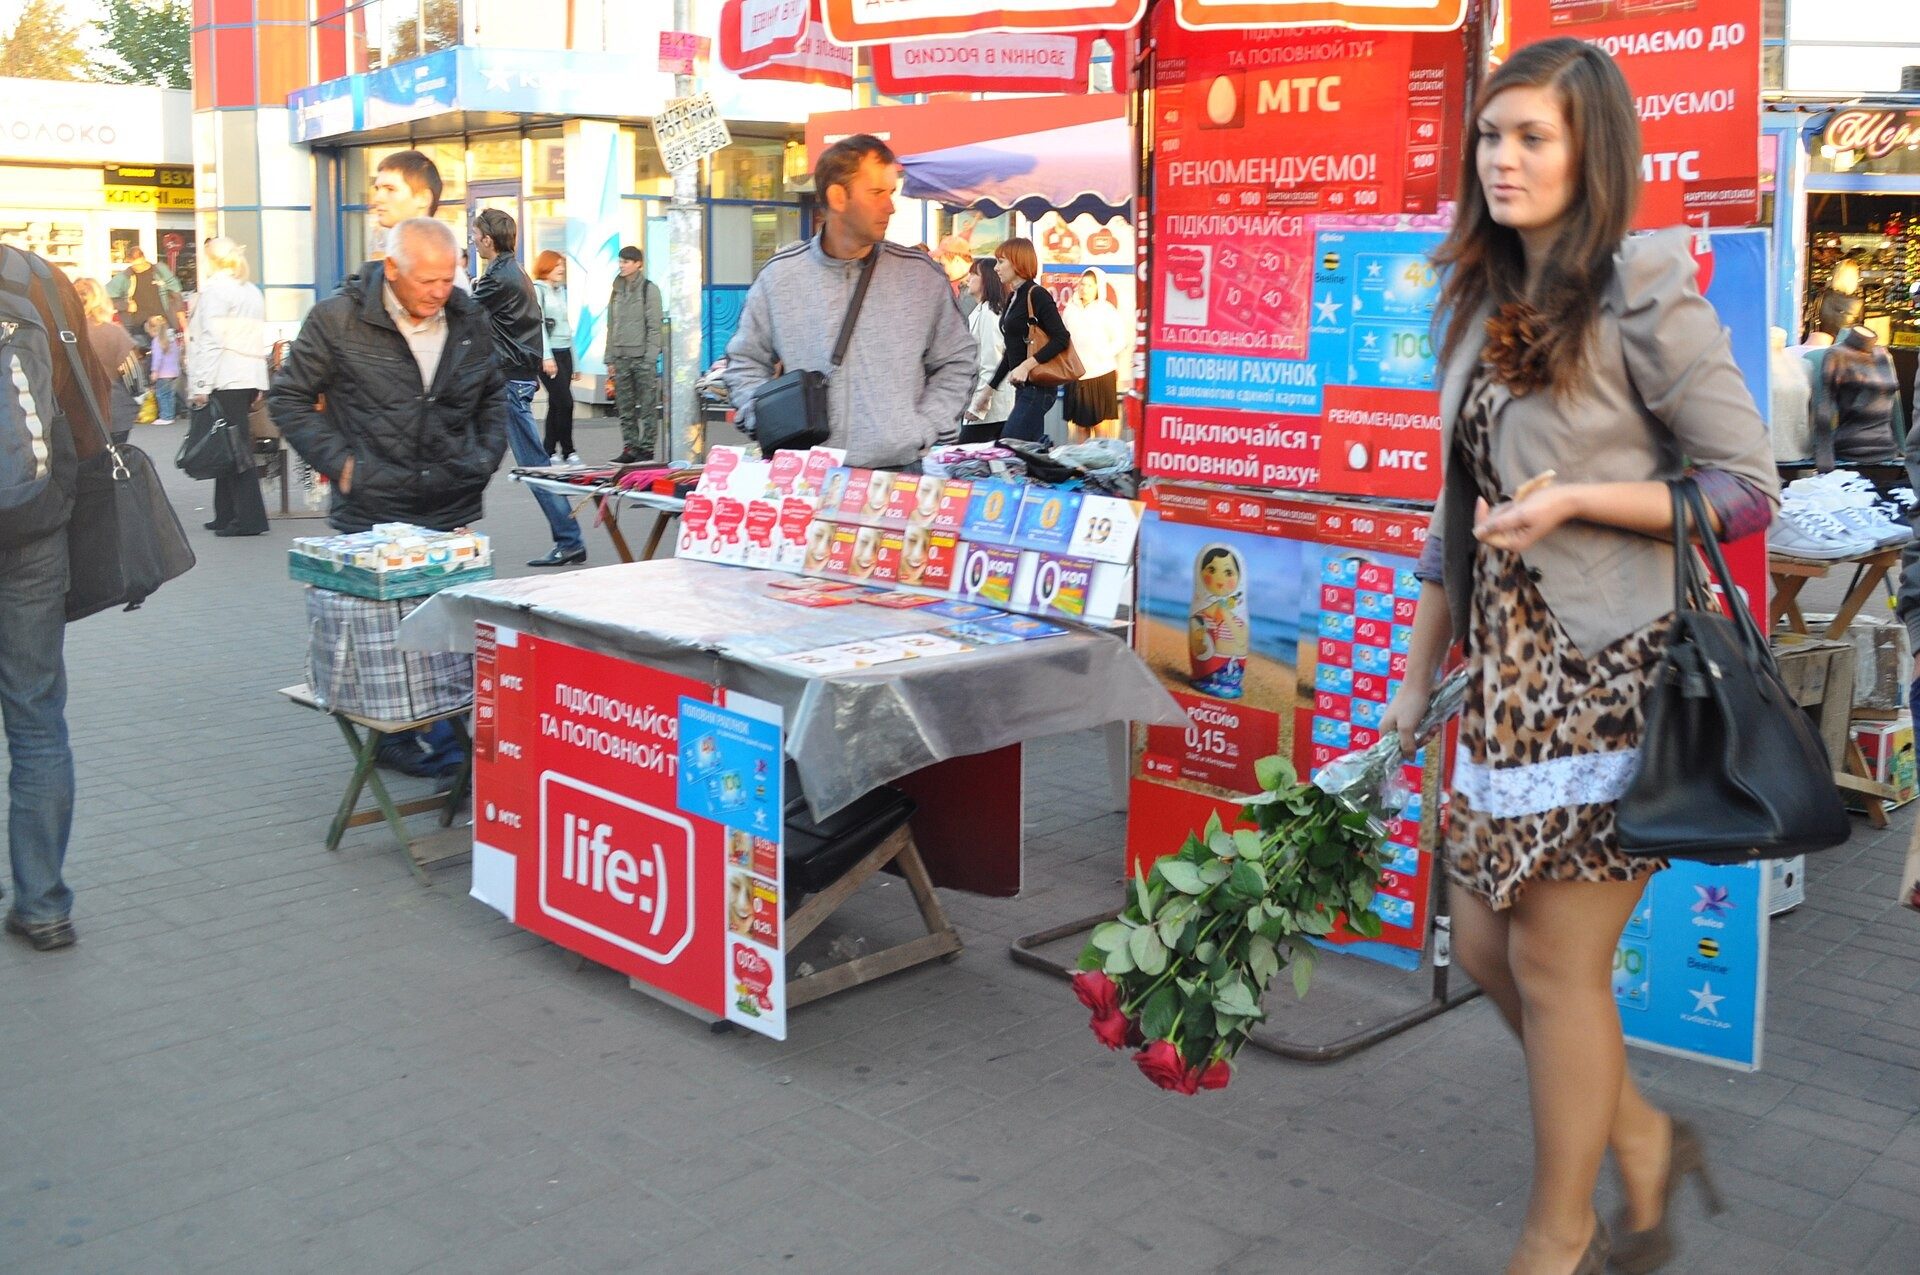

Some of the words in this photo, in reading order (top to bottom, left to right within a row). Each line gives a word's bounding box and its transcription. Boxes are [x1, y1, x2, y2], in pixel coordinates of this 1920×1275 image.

[1708, 23, 1745, 51] ДО
[1228, 50, 1246, 66] ТА
[1248, 39, 1344, 64] ПОПОВНЮЙ
[1350, 40, 1375, 58] ТУТ
[1257, 75, 1341, 115] МТС
[1416, 123, 1434, 138] 40
[1168, 153, 1376, 189] РЕКОМЕНДУЄМО!
[1412, 153, 1435, 169] 100
[1353, 190, 1378, 206] 100
[1166, 213, 1303, 239] ПІДКЛЮЧАЙСЯ
[1219, 249, 1239, 269] 25
[1403, 260, 1438, 289] 40
[1225, 287, 1242, 306] 10
[1161, 327, 1178, 343] ТА
[1391, 332, 1433, 359] 100
[1165, 356, 1239, 382] ПОПОВНИ
[1241, 361, 1317, 387] РАХУНОК
[1165, 384, 1177, 396] за
[1178, 385, 1236, 400] допомогою
[1237, 389, 1274, 404] єдиної
[1276, 393, 1317, 407] картки
[1327, 408, 1443, 431] РЕКОМЕНДУЄМО
[1160, 416, 1307, 449] Підключайся
[1146, 452, 1260, 478] поповнюй
[1262, 463, 1320, 488] рахун
[1378, 448, 1428, 471] МТС
[983, 490, 1005, 521] 0
[1040, 499, 1062, 529] 0
[1215, 501, 1231, 514] 40
[1239, 502, 1261, 518] 100
[1084, 516, 1113, 544] 19
[1325, 515, 1341, 529] 40
[1350, 517, 1375, 534] 100
[1385, 524, 1402, 538] 40
[1360, 569, 1379, 583] 40
[1324, 588, 1339, 603] 10
[1395, 602, 1414, 617] 50
[1357, 623, 1376, 637] 40
[1321, 641, 1335, 656] 10
[480, 678, 493, 692] 40
[499, 673, 524, 692] МТС
[1355, 677, 1372, 691] 40
[555, 682, 678, 741] ПІДКЛЮЧАЙСЯ
[1318, 695, 1333, 709] 10
[1186, 706, 1240, 729] РОССИЮ
[498, 739, 522, 760] МТС
[540, 712, 560, 739] ТА
[562, 719, 664, 774] ПОПОВНЮЙ
[1185, 725, 1226, 753] 0,15
[1353, 732, 1371, 745] 40
[1315, 747, 1330, 762] 10
[498, 808, 522, 829] МТС
[562, 812, 669, 937] life:)
[1686, 956, 1729, 975] Beeline
